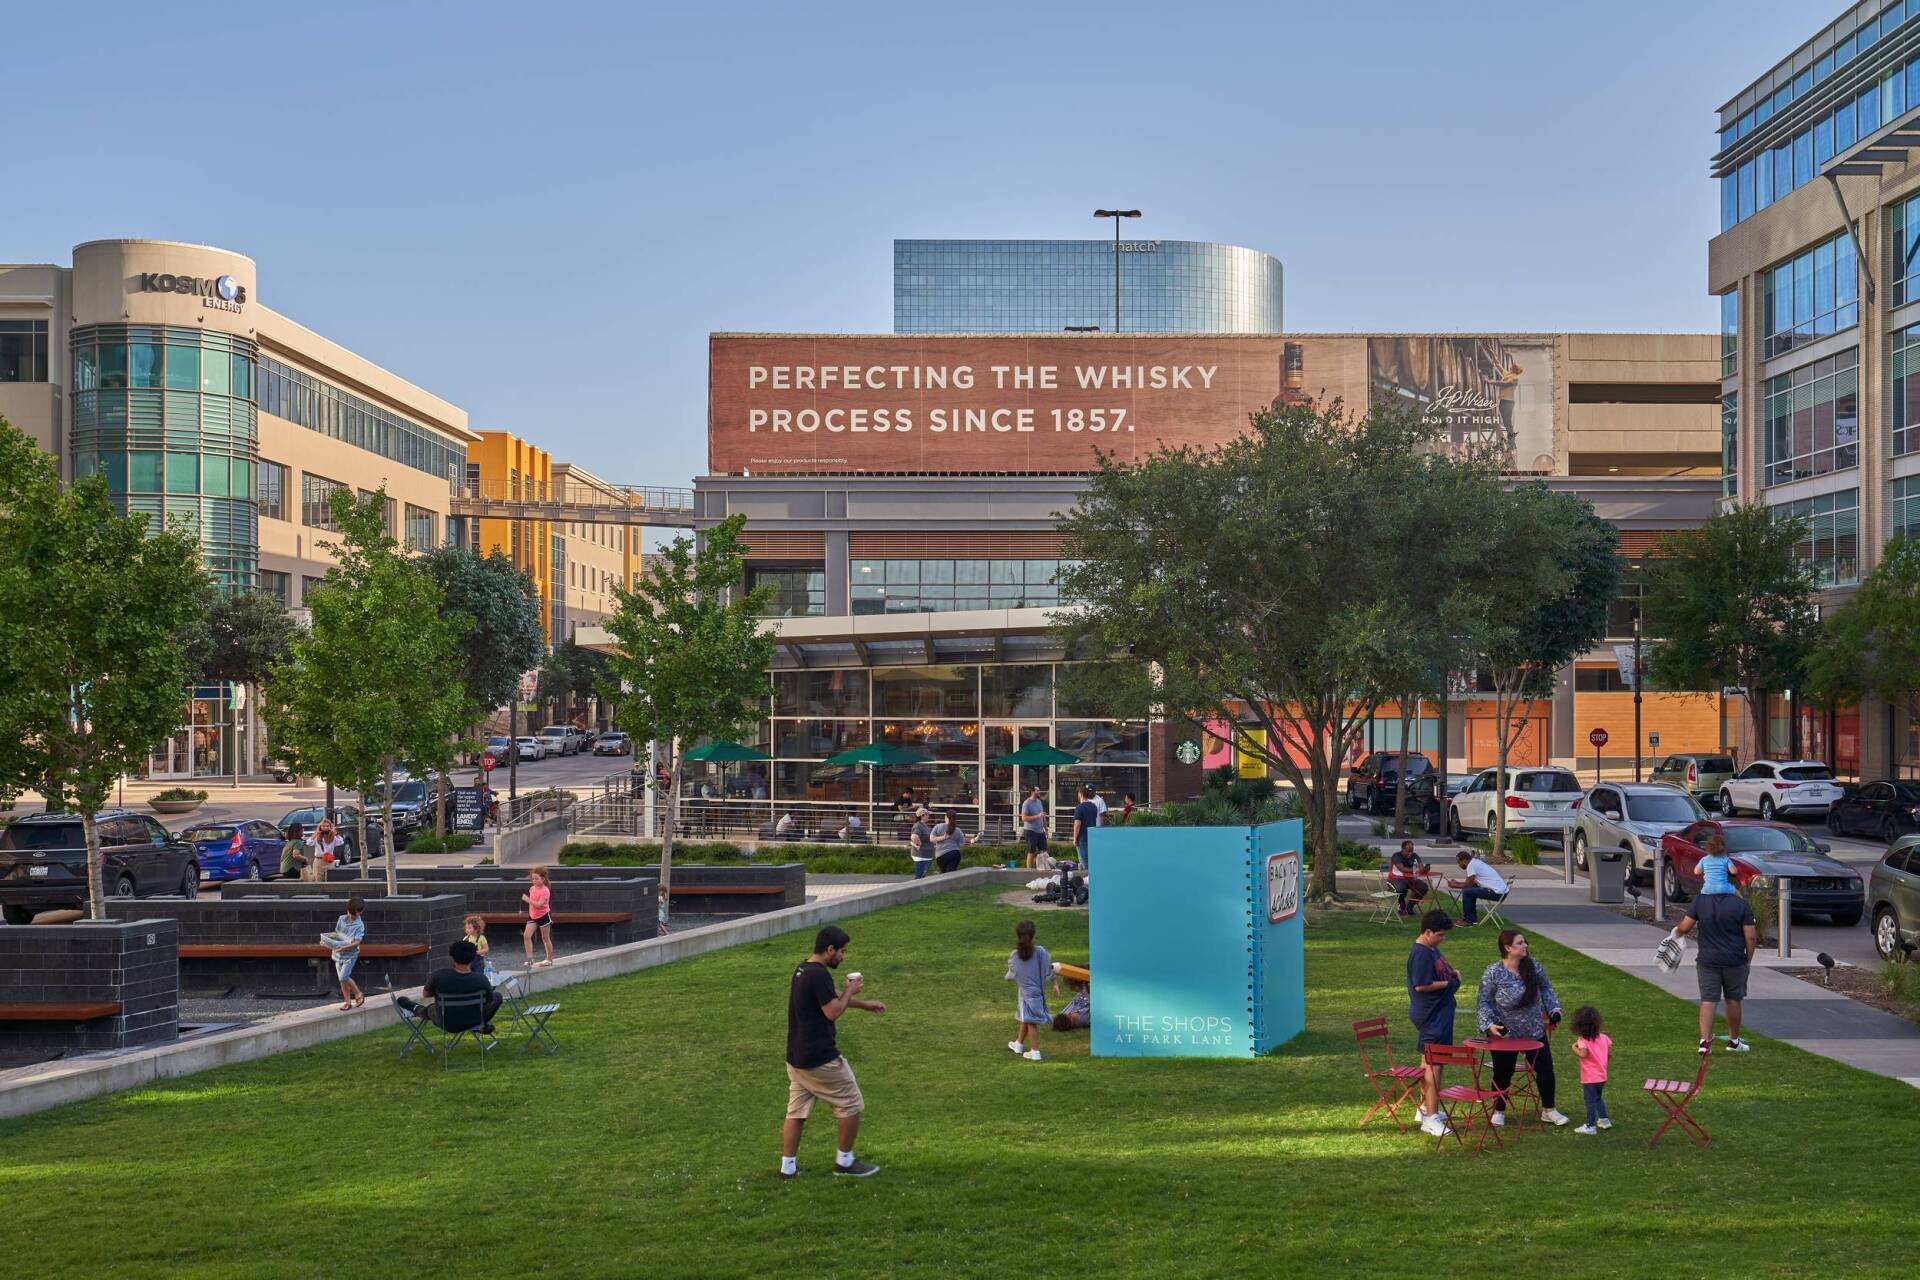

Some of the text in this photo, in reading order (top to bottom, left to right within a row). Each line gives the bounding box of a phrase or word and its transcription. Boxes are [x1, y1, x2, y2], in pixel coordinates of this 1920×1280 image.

[1112, 241, 1156, 252] match
[141, 272, 246, 304] KOSMOS
[203, 298, 245, 314] ENERGY
[749, 365, 1219, 390] PERFECTING THE WHISKY
[749, 408, 1135, 433] PROCESS SINCE 1857.
[1457, 416, 1468, 424] IT
[1472, 416, 1500, 424] HIGH
[1591, 733, 1607, 742] STOP
[483, 758, 496, 766] TOP
[1270, 860, 1297, 881] BACK TO
[1271, 876, 1298, 915] school
[1114, 1015, 1232, 1032] THE SHOPS
[1114, 1034, 1233, 1045] AT PARK LANE
